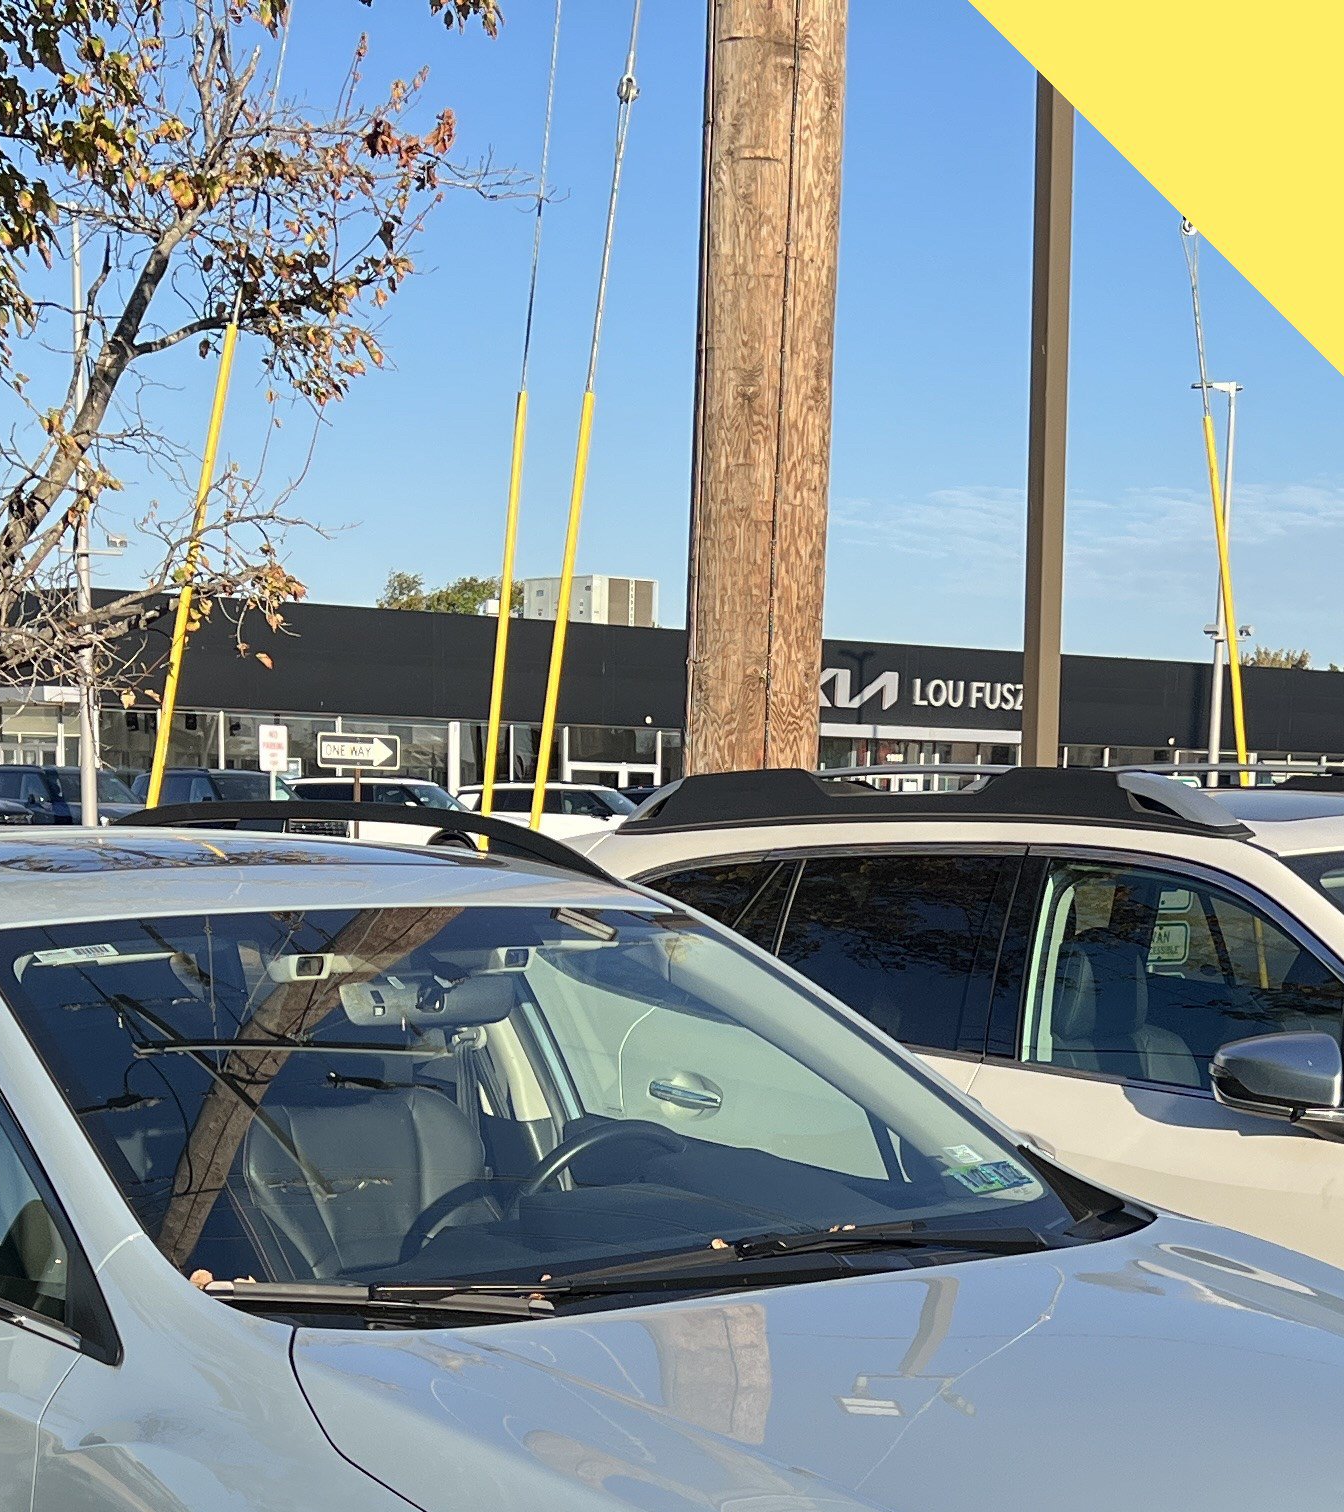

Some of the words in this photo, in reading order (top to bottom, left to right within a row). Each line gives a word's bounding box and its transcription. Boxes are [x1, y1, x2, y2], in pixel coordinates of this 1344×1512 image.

[912, 678, 965, 708] LOU
[325, 743, 345, 756] ONE
[350, 745, 372, 757] WAY
